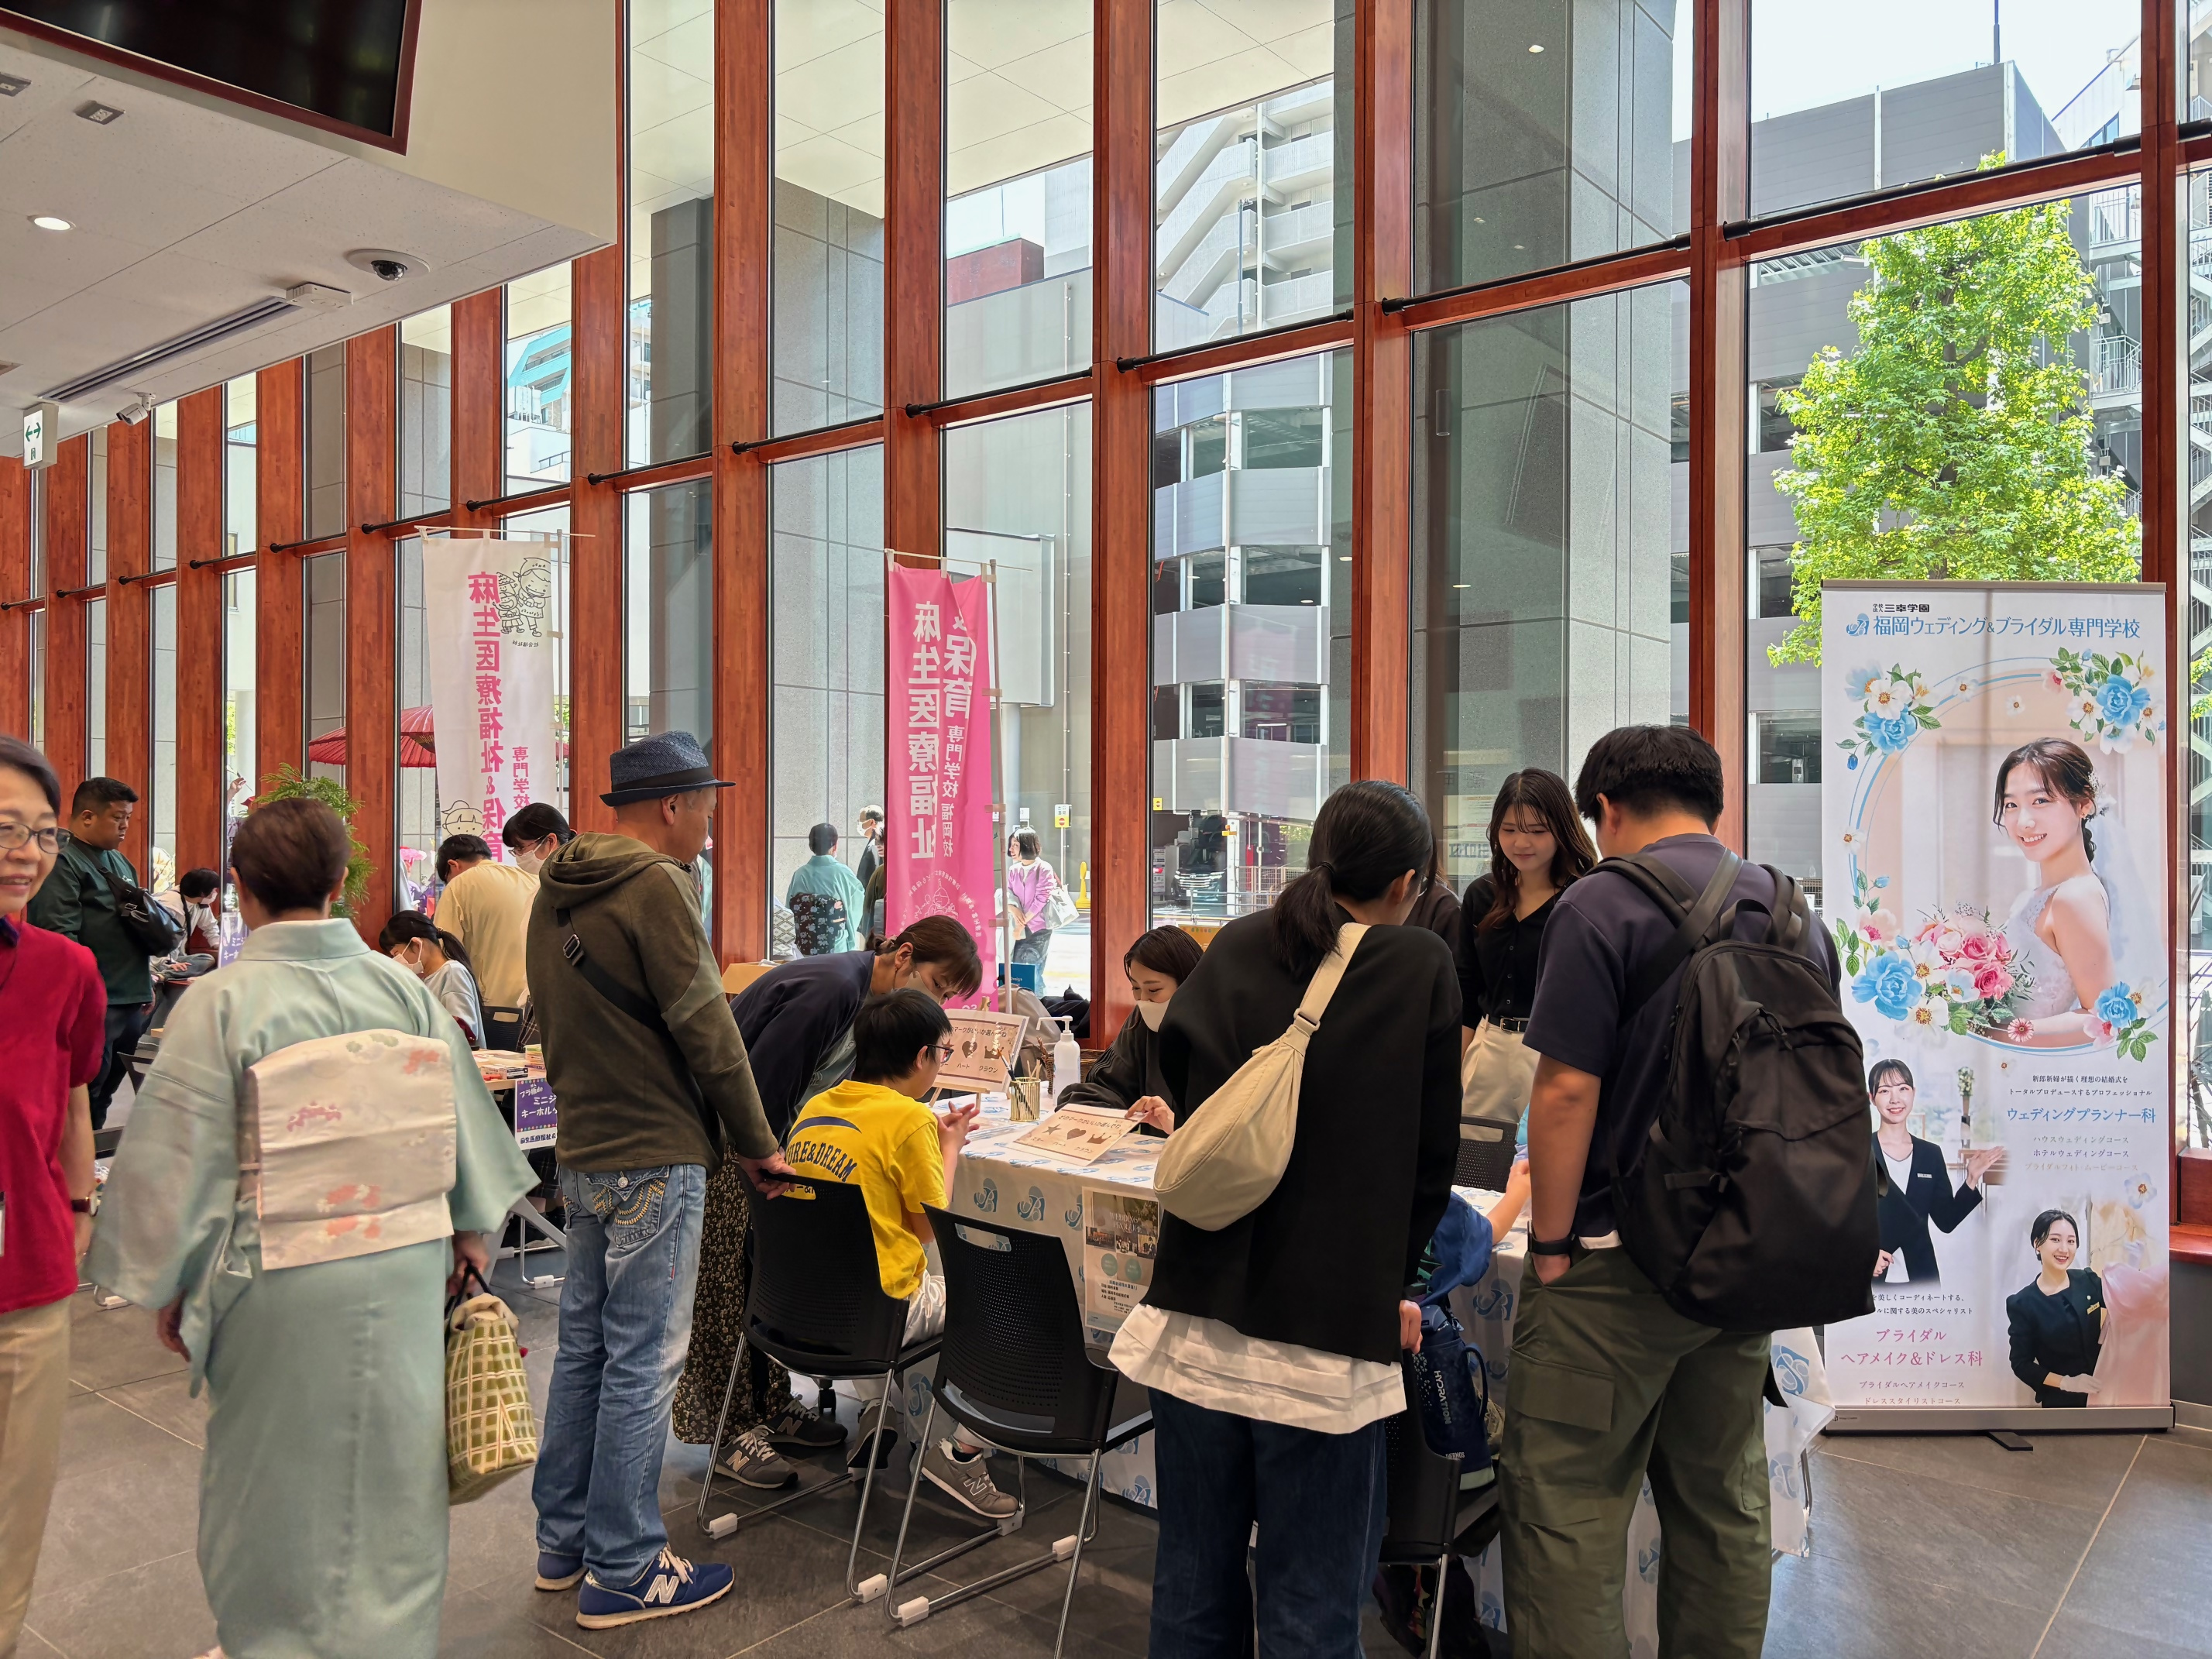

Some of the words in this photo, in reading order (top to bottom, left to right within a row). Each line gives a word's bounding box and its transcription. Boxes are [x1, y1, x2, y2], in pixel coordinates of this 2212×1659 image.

[1884, 603, 1930, 613] 三幸学園
[1873, 616, 2141, 638] 福岡ウェディング&ブライダル専門学校
[978, 1065, 998, 1073] クラウン
[2032, 1074, 2128, 1084] 新郎新婦が描く理想の結婚式を
[2009, 1088, 2152, 1097] トータルプロデュースするプロフェッショナル
[2007, 1107, 2156, 1123] ウェディングプランナー科
[2033, 1135, 2129, 1144] ハウスウェディングコース
[2033, 1149, 2129, 1158] ホテルウェディングコース
[1877, 1328, 1947, 1343] ブライダル
[1840, 1350, 1983, 1367] ヘアメイク&ドレス科
[1859, 1380, 1965, 1389] ブライダルヘアメイクコース
[1434, 1370, 1452, 1424] HYDRATION
[1865, 1396, 1961, 1405] ドレススタイリストコース
[777, 1416, 803, 1437] N
[726, 1449, 750, 1472] N
[963, 1476, 988, 1496] N
[644, 1574, 681, 1604] N
